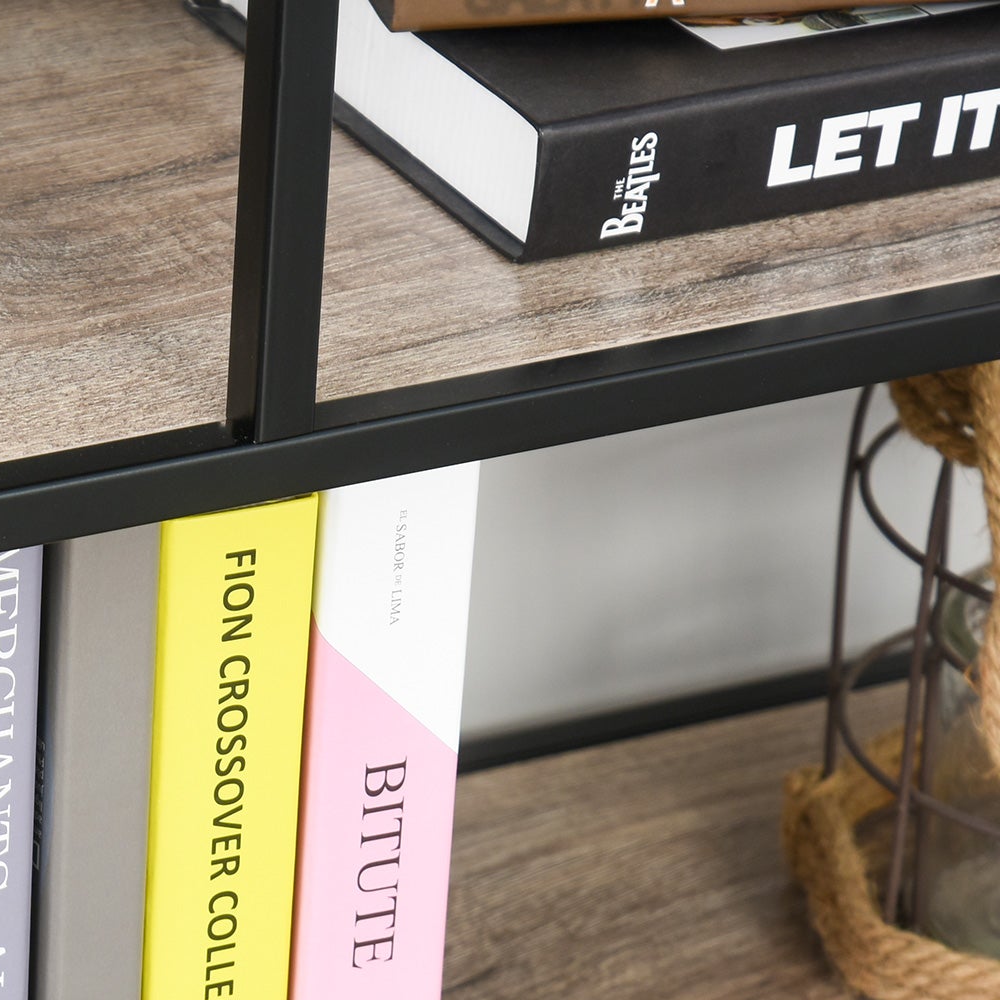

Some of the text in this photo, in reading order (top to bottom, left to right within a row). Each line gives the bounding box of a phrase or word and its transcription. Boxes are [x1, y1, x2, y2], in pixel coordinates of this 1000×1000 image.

[600, 131, 660, 239] BEATLES
[766, 87, 1000, 188] LET IT
[613, 177, 625, 200] THE
[221, 548, 257, 642] FION
[393, 523, 407, 572] SABOR
[389, 589, 402, 626] LIMA
[210, 654, 251, 881] CROSSOVER
[352, 757, 408, 969] BITUTE
